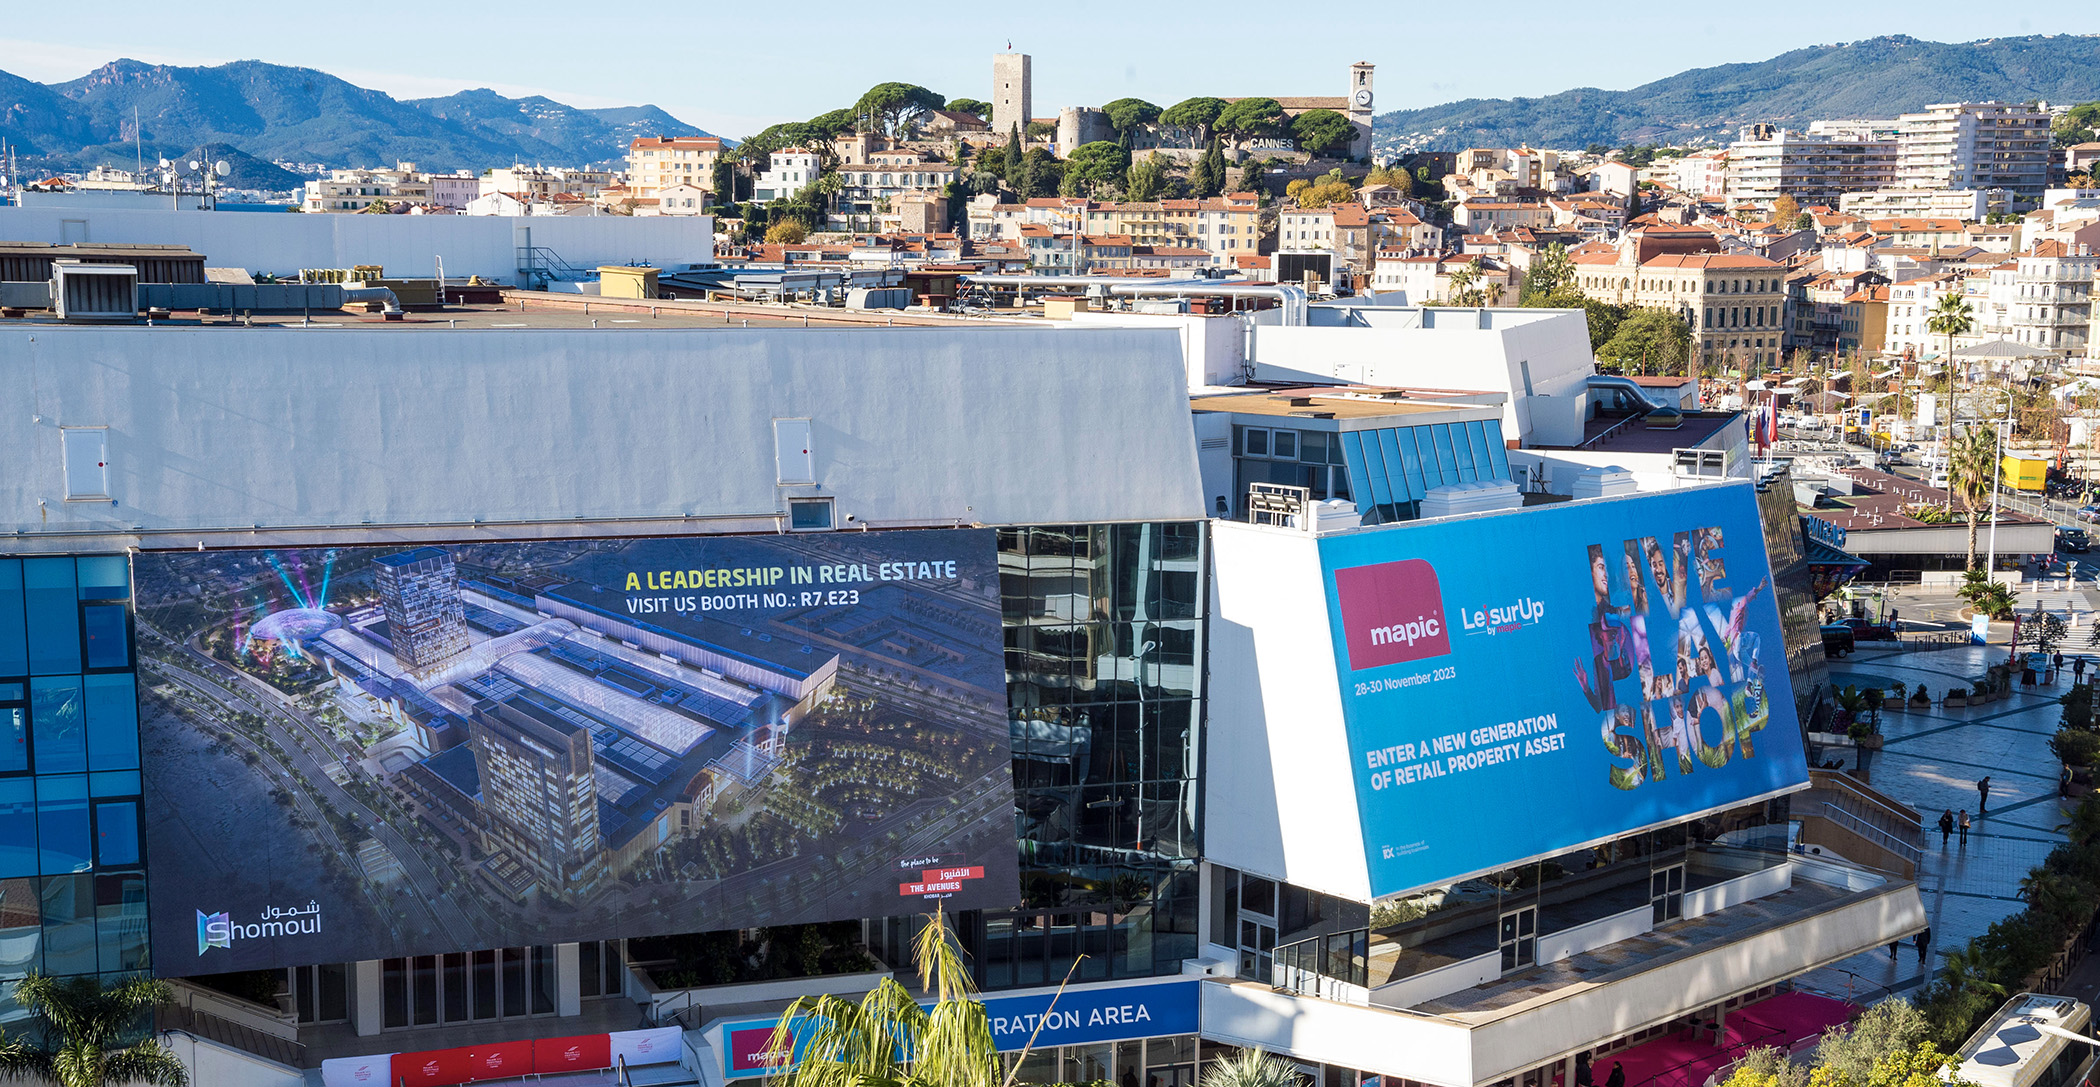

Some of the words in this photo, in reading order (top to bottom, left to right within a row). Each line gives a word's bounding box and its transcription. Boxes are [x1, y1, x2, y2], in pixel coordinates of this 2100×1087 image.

[1250, 138, 1294, 149] CANNES
[625, 572, 641, 591] A
[647, 566, 783, 590] LEADERSHIP
[790, 566, 813, 585] IN
[819, 564, 874, 583] REAL
[879, 560, 957, 580] ESTATE
[1587, 526, 1733, 619] LIVE
[625, 597, 669, 614] VISIT
[674, 597, 696, 612] US
[701, 594, 758, 611] BOOTH
[763, 592, 797, 609] NO.:
[800, 590, 860, 608] R7.E23
[1370, 615, 1440, 646] mapic
[1487, 626, 1496, 636] by
[1496, 621, 1522, 634] mapic
[1588, 597, 1750, 711] PLAY
[1354, 680, 1383, 696] 28-30
[1384, 672, 1431, 691] November
[1433, 666, 1456, 681] 2023
[1366, 743, 1416, 769] ENTER
[1420, 741, 1430, 758] A
[1432, 732, 1466, 755] NEW
[1470, 713, 1557, 746] GENERATION
[1600, 682, 1769, 791] SHOP
[1371, 771, 1392, 791] OF
[1395, 760, 1446, 786] RETAIL
[1448, 743, 1520, 774] PROPERTY
[1525, 733, 1566, 757] ASSET
[900, 860, 909, 868] the
[910, 859, 925, 869] place
[910, 884, 924, 893] THE
[927, 881, 960, 892] AVENUES
[206, 913, 321, 942] Shomoul
[1088, 1004, 1151, 1027] AREA
